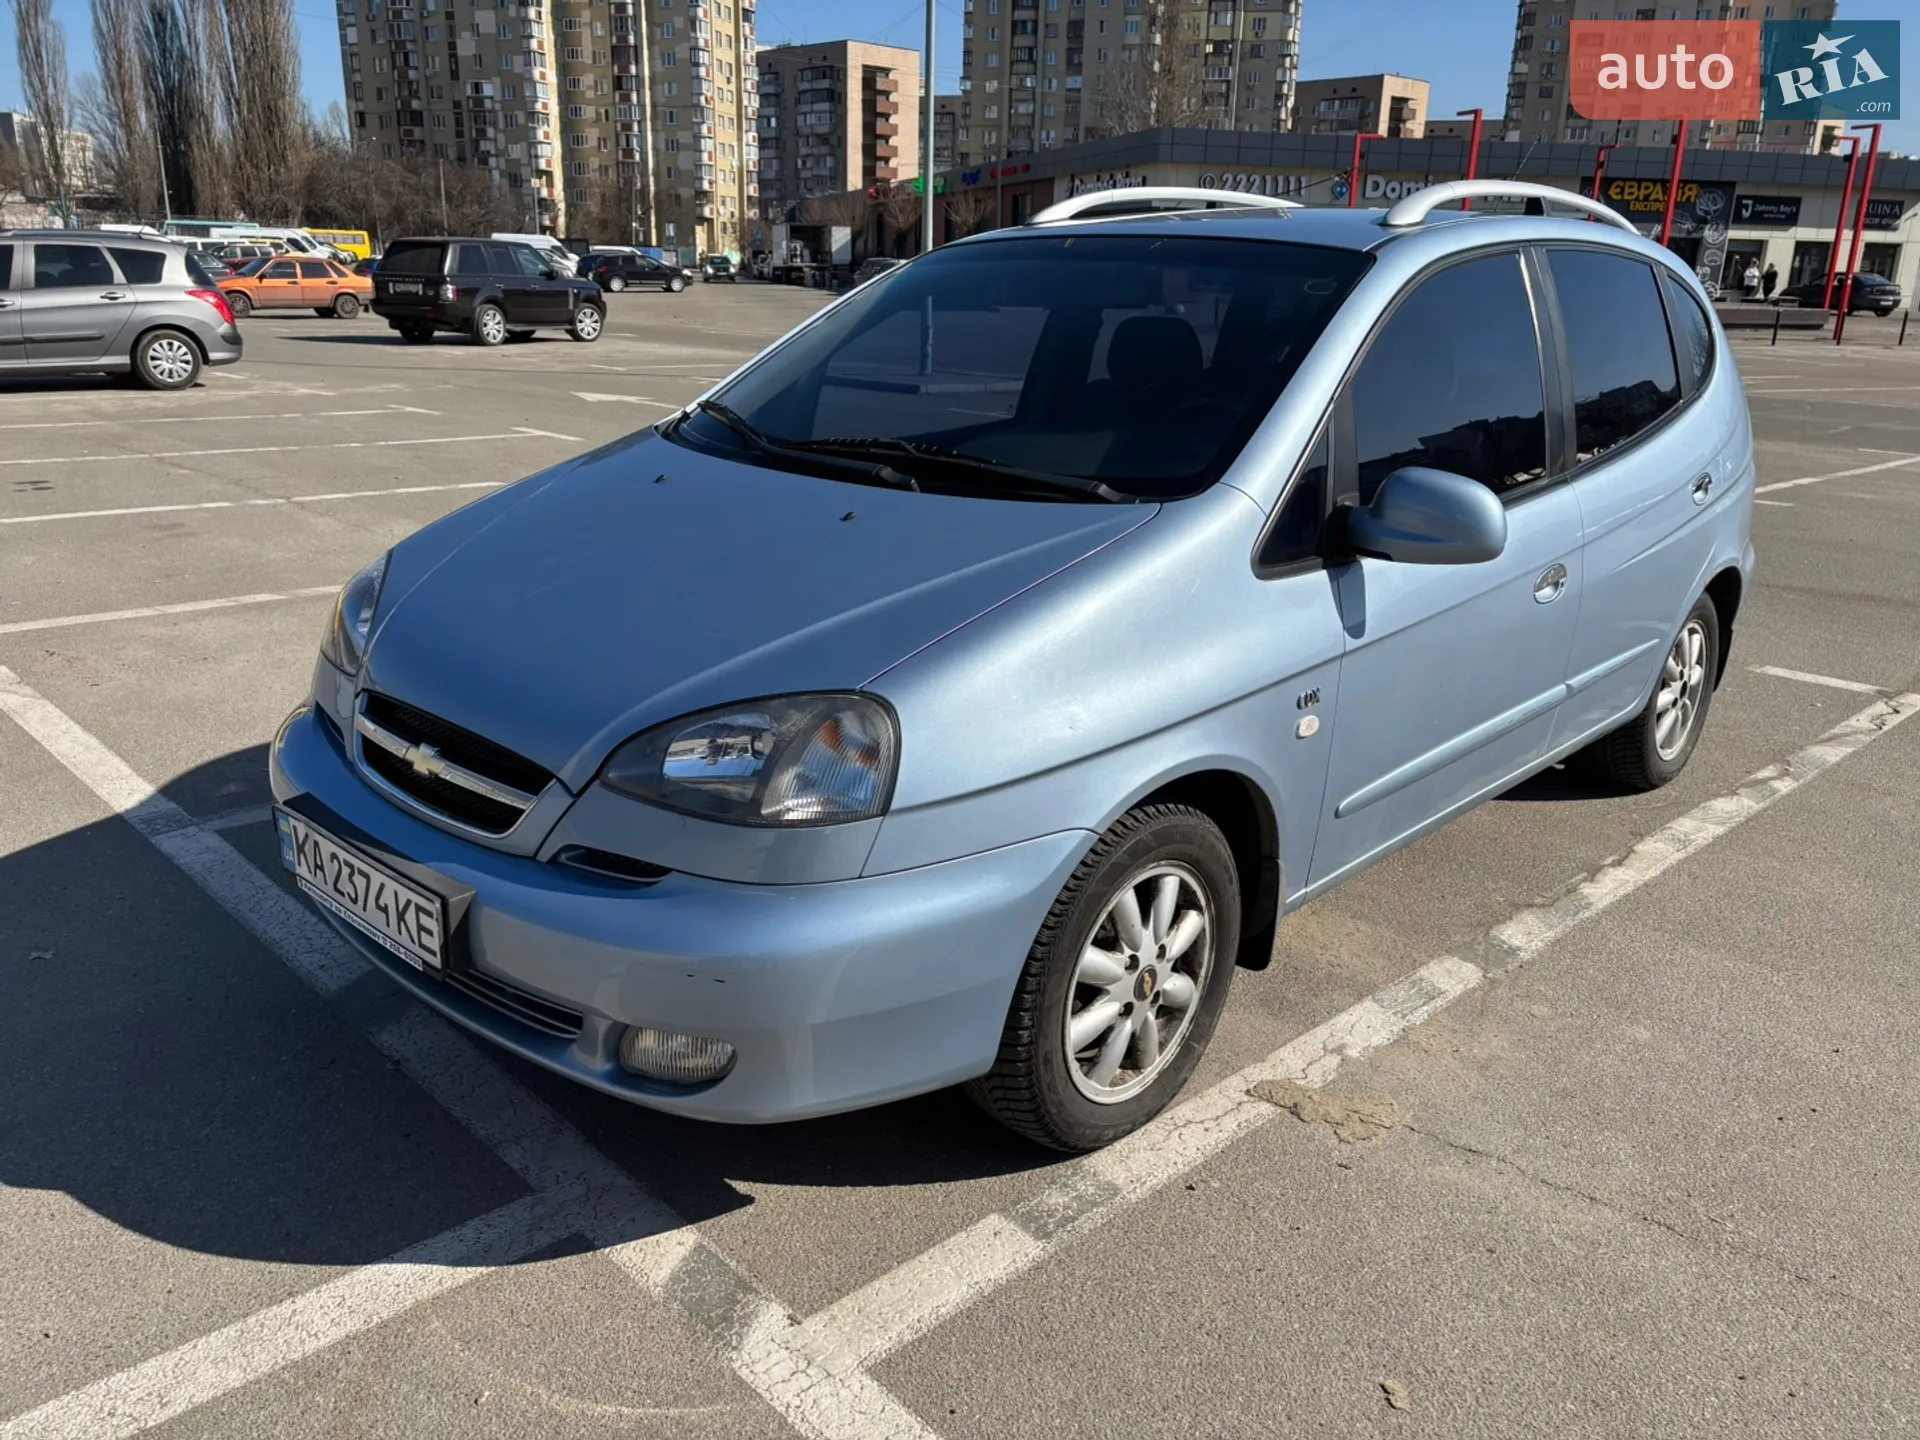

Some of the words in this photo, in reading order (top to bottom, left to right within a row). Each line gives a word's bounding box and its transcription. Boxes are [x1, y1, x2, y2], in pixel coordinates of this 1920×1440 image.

[1221, 173, 1307, 196] 2221111
[1608, 180, 1698, 203] ЄВРАіЯ
[1629, 201, 1667, 212] ЕКСПРЕ
